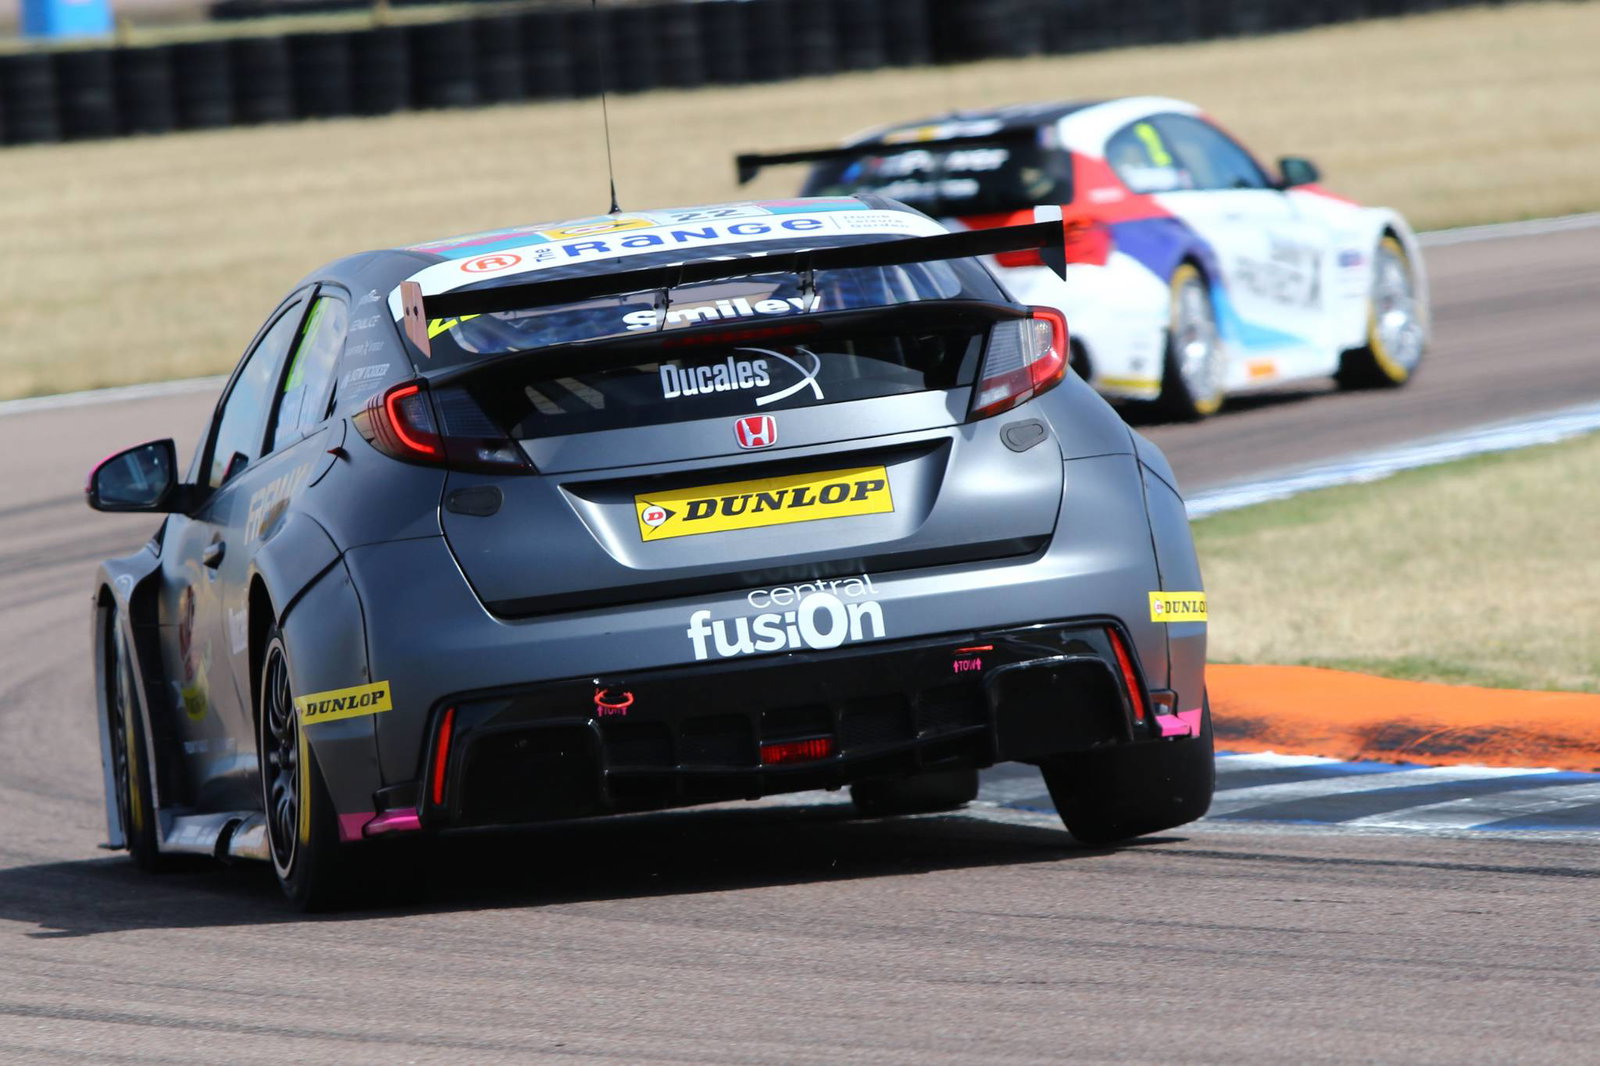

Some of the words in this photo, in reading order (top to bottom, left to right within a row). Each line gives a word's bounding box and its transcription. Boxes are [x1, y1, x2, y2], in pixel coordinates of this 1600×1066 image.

[659, 356, 770, 399] Ducales
[682, 478, 885, 522] DUNLOP
[747, 573, 879, 609] central
[1165, 600, 1208, 614] DUNLO
[958, 660, 977, 672] TOW
[306, 690, 385, 717] DUNLOP
